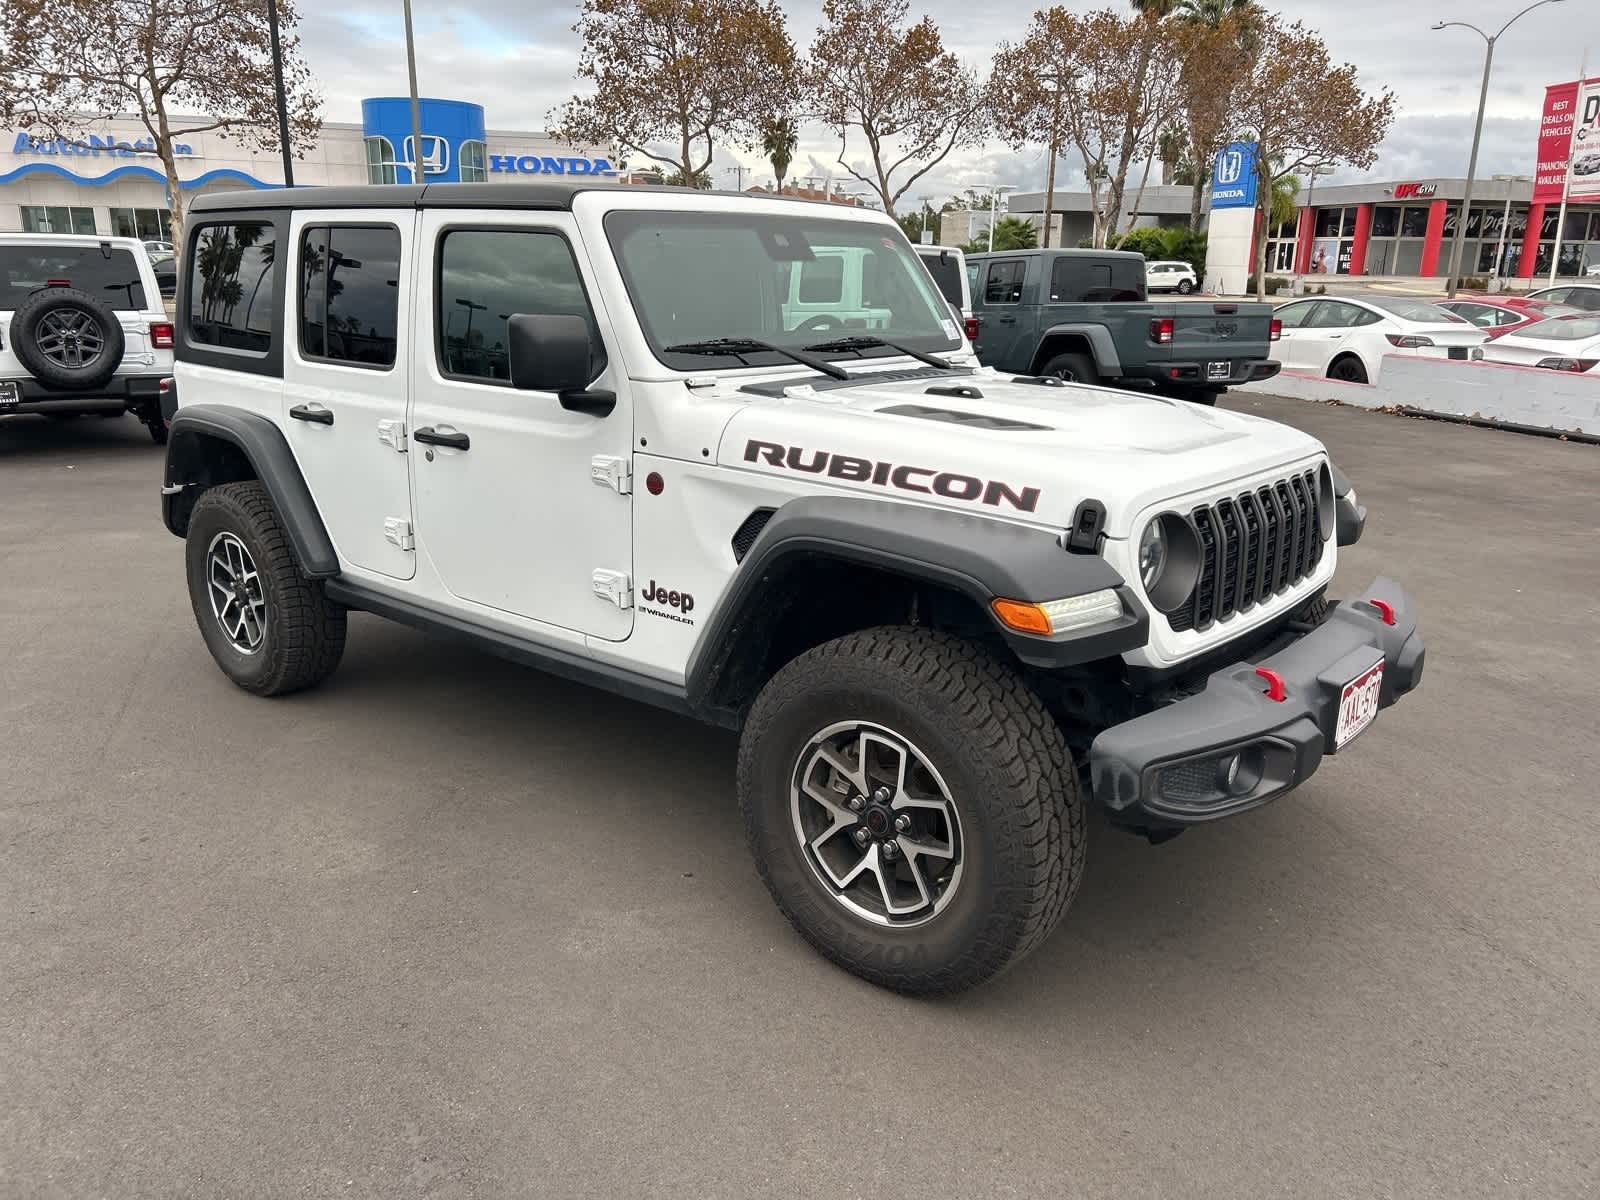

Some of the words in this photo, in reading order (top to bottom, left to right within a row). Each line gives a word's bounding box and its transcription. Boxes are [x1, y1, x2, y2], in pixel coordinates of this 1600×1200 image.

[1552, 101, 1569, 111] BEST
[1542, 113, 1563, 125] DEALS
[1563, 112, 1575, 122] ON
[1541, 126, 1572, 137] VEHICLES
[13, 132, 193, 157] AutoNatin
[489, 155, 617, 176] HONDA
[1537, 161, 1568, 172] FINANCING
[1537, 175, 1567, 185] AVAILABLE
[1212, 190, 1245, 199] HONDA
[1394, 183, 1421, 198] UFC
[1419, 185, 1437, 194] GYM
[1216, 321, 1238, 336] Jeep
[744, 439, 1041, 513] RUBICON
[642, 580, 694, 614] Jeep
[646, 607, 695, 625] WRANGLER
